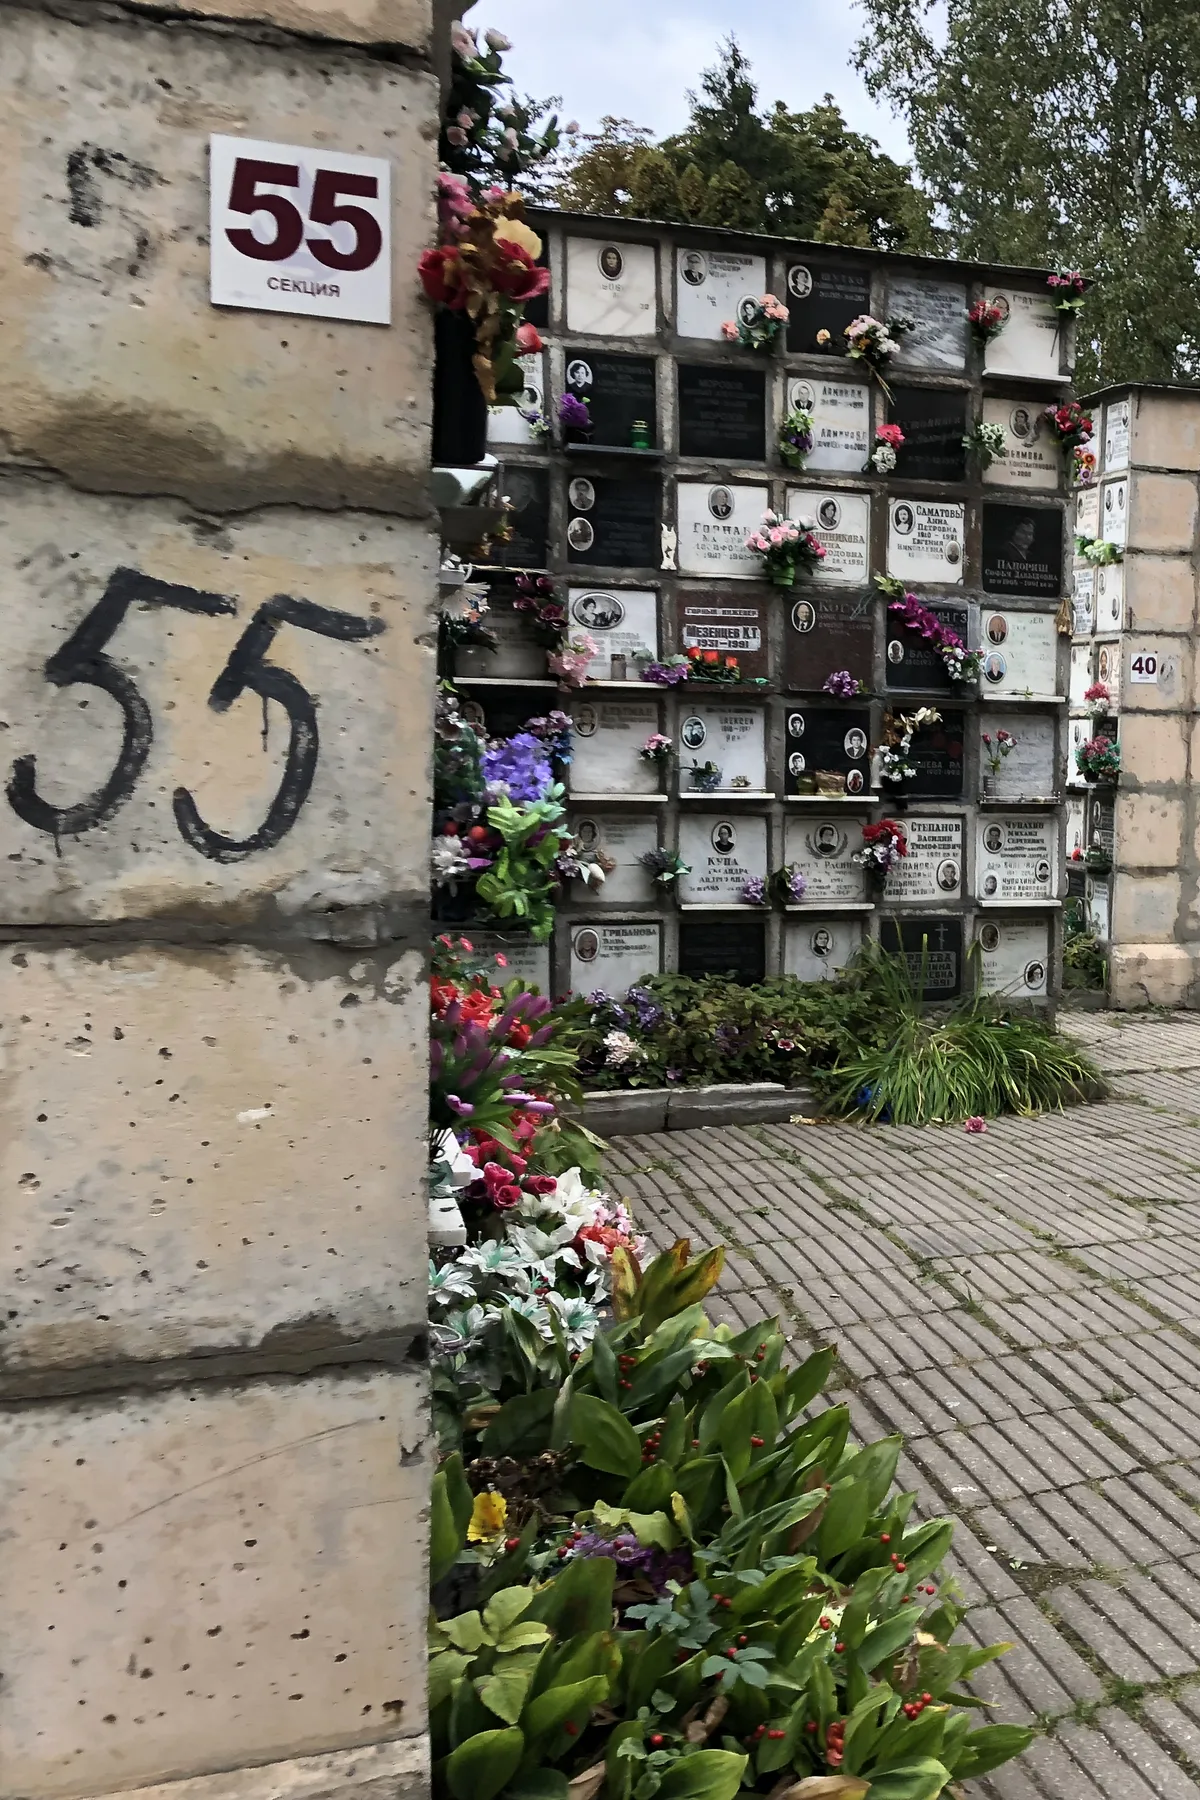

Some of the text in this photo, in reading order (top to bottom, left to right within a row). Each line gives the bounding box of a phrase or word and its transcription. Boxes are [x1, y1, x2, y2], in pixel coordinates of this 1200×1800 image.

[225, 157, 383, 271] 55
[266, 276, 341, 298] СЕКЦИЯ
[916, 505, 964, 519] САМАТОВЫ
[926, 517, 948, 526] АННА
[917, 523, 957, 534] ПЕТРОВНА
[912, 537, 944, 547] ЕВГЕНИЯ
[686, 625, 740, 639] МЕЗЕНЦЕВ
[1131, 656, 1157, 675] 40
[6, 565, 387, 863] 55
[911, 821, 961, 832] СТЕПАНОВ
[1005, 821, 1045, 830] ЧУПАХИН
[708, 857, 738, 866] КУПА
